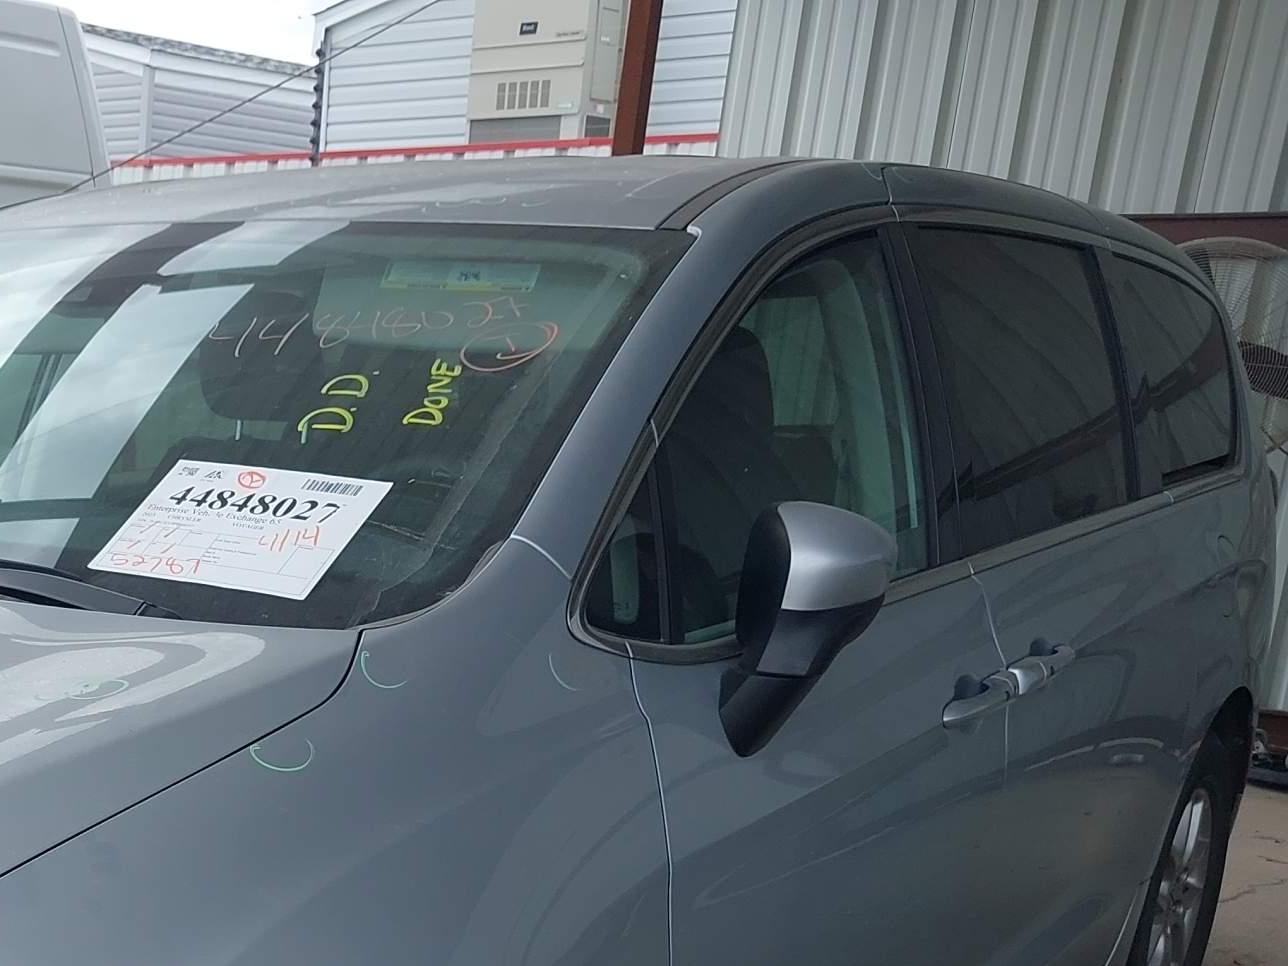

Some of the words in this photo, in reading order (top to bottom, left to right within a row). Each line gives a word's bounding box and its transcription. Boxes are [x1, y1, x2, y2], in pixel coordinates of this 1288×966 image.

[402, 357, 462, 427] DONE
[147, 504, 190, 515] Enterprise
[225, 512, 268, 524] Exchange
[169, 485, 341, 524] 44848027
